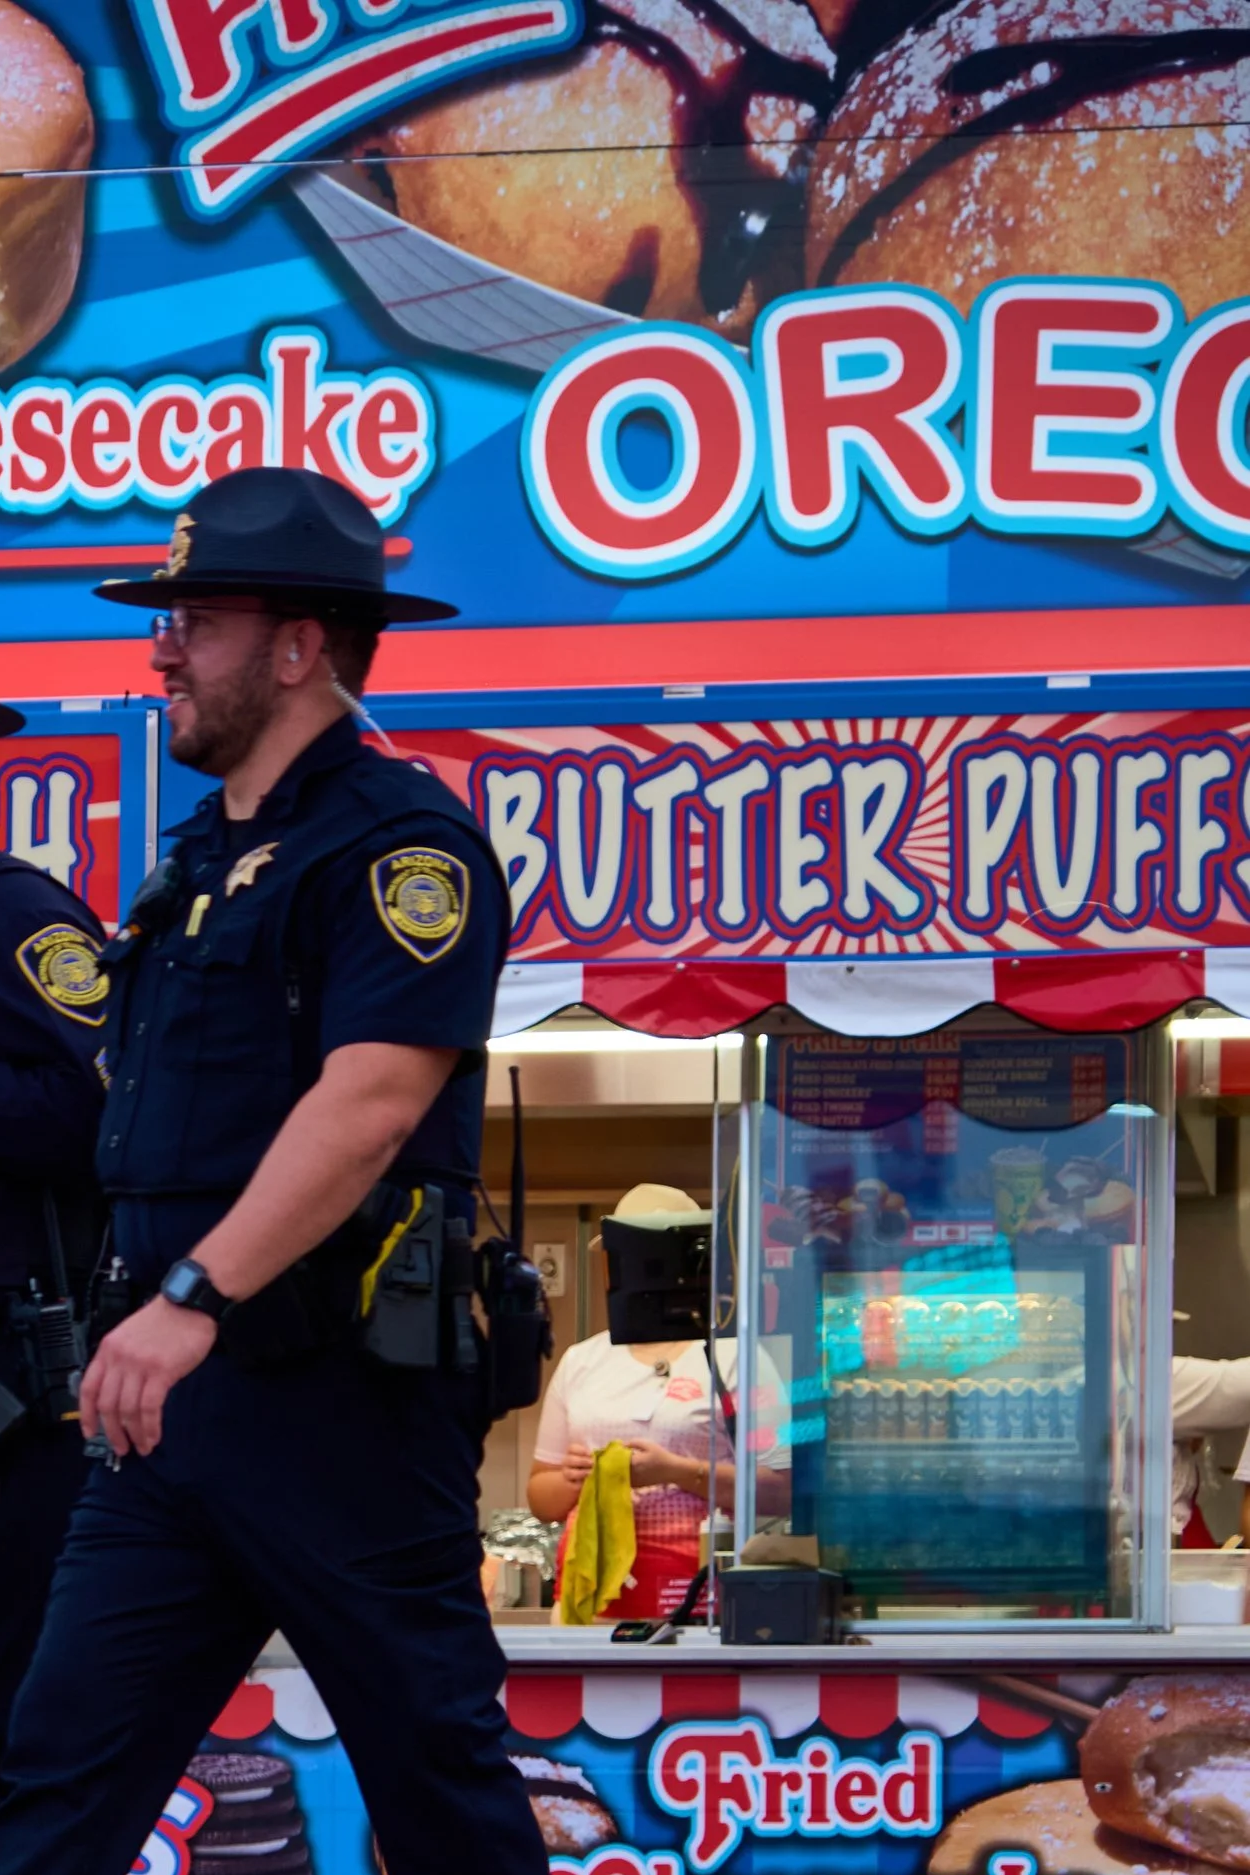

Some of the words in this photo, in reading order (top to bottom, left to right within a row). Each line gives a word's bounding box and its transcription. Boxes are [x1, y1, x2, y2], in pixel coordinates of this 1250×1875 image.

[485, 757, 923, 929] BUTTER
[965, 748, 1250, 923] PUFF
[658, 1727, 934, 1869] Fried
